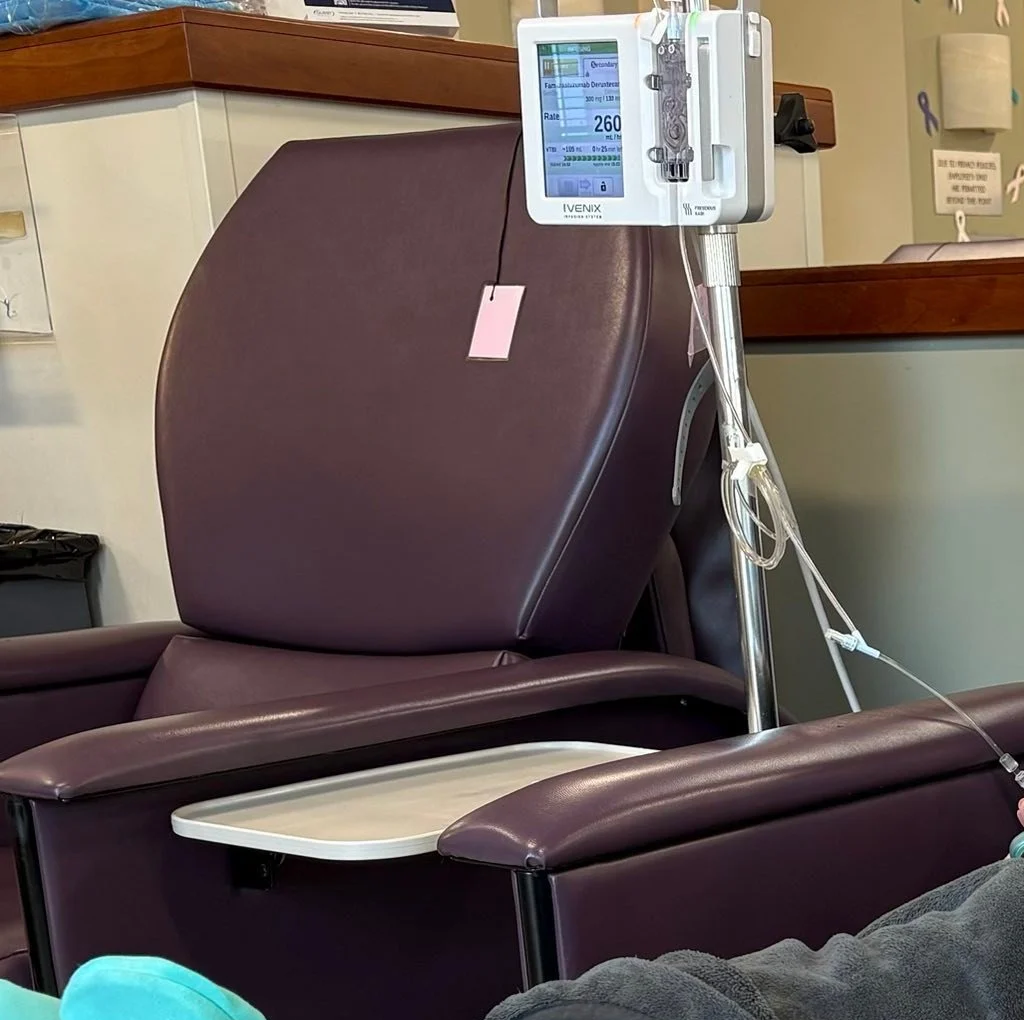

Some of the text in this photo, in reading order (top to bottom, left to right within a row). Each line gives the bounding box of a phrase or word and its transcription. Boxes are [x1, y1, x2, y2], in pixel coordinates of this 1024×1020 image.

[544, 112, 560, 120] Rate
[594, 114, 622, 132] 260
[563, 203, 602, 213] IVENIX
